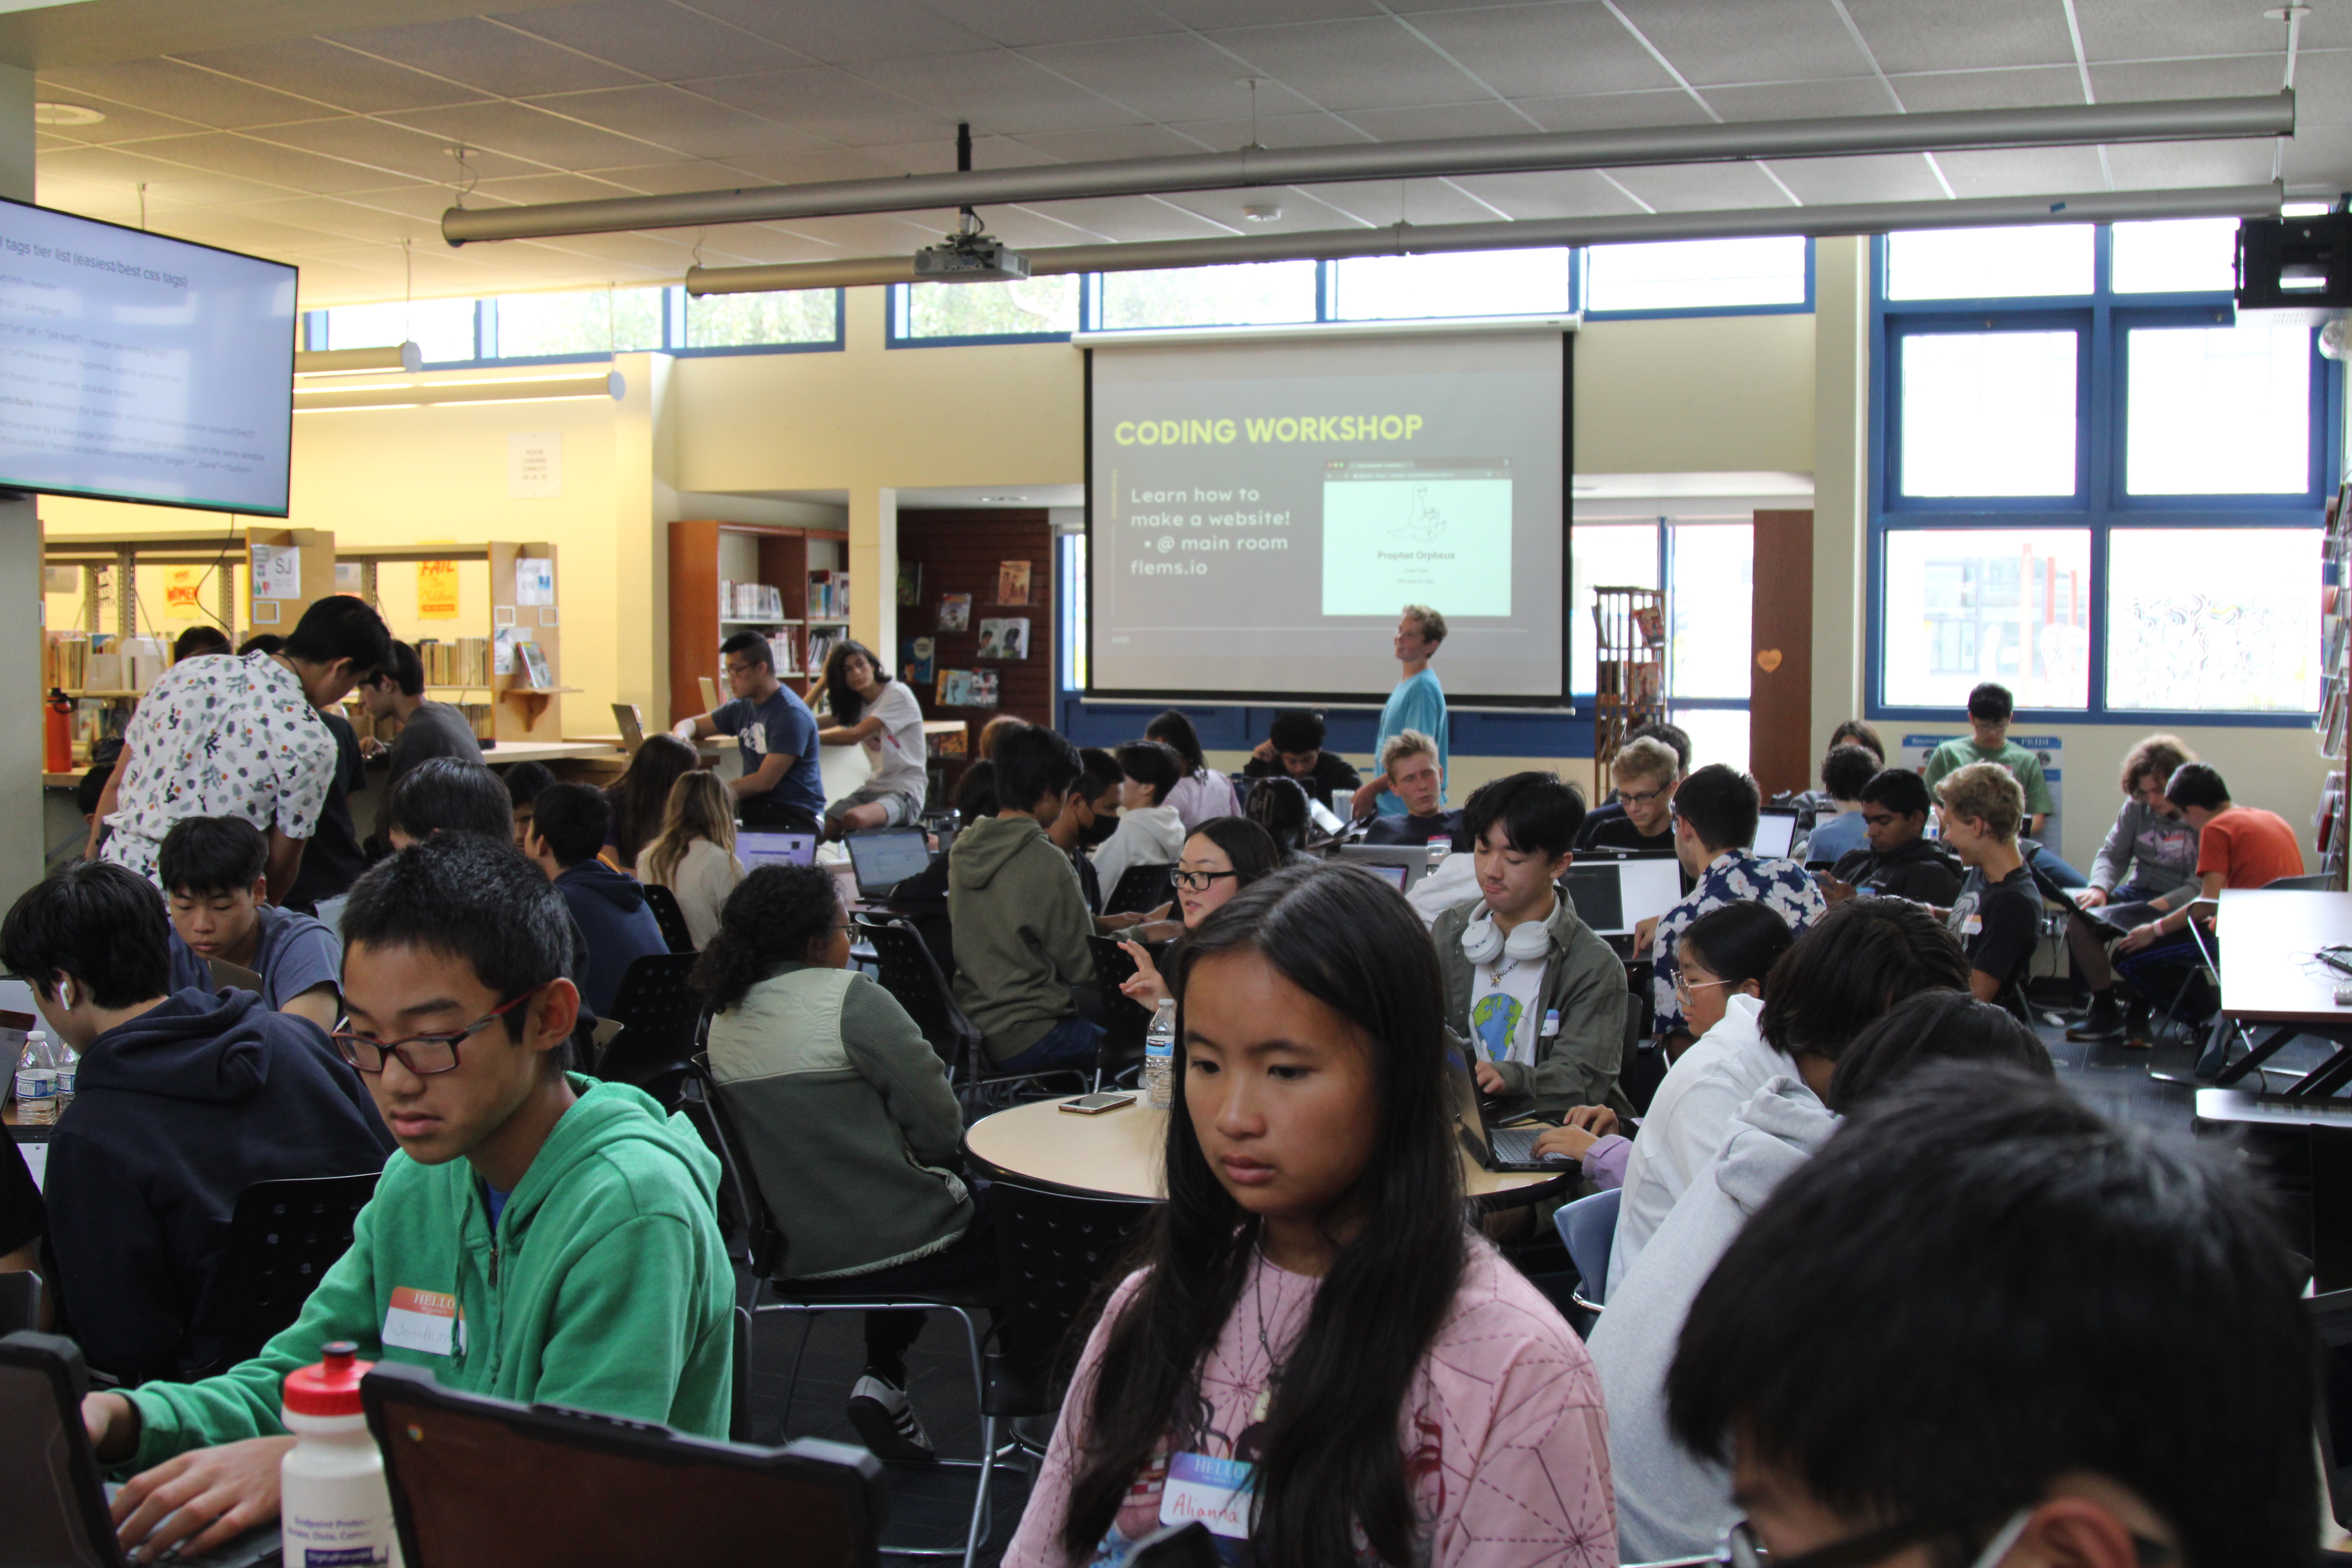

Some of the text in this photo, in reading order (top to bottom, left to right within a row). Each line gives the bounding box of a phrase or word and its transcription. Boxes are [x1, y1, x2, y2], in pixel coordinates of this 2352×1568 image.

[5, 238, 30, 255] tags
[33, 245, 52, 258] tier
[55, 247, 71, 263] list
[143, 268, 160, 282] css
[163, 271, 188, 289] tags)
[1114, 414, 1424, 446] CODING WORKSHOP
[1131, 486, 1259, 504] Learn how to
[1131, 510, 1291, 527] make a website!
[1156, 535, 1289, 554] @ main room
[1377, 551, 1455, 561] Prophet Orpheus
[275, 557, 292, 575] SJ
[1131, 559, 1208, 576] flems.io
[414, 1293, 455, 1309] HELLO
[1194, 1459, 1246, 1479] HELLO
[1172, 1492, 1238, 1524] Alianna
